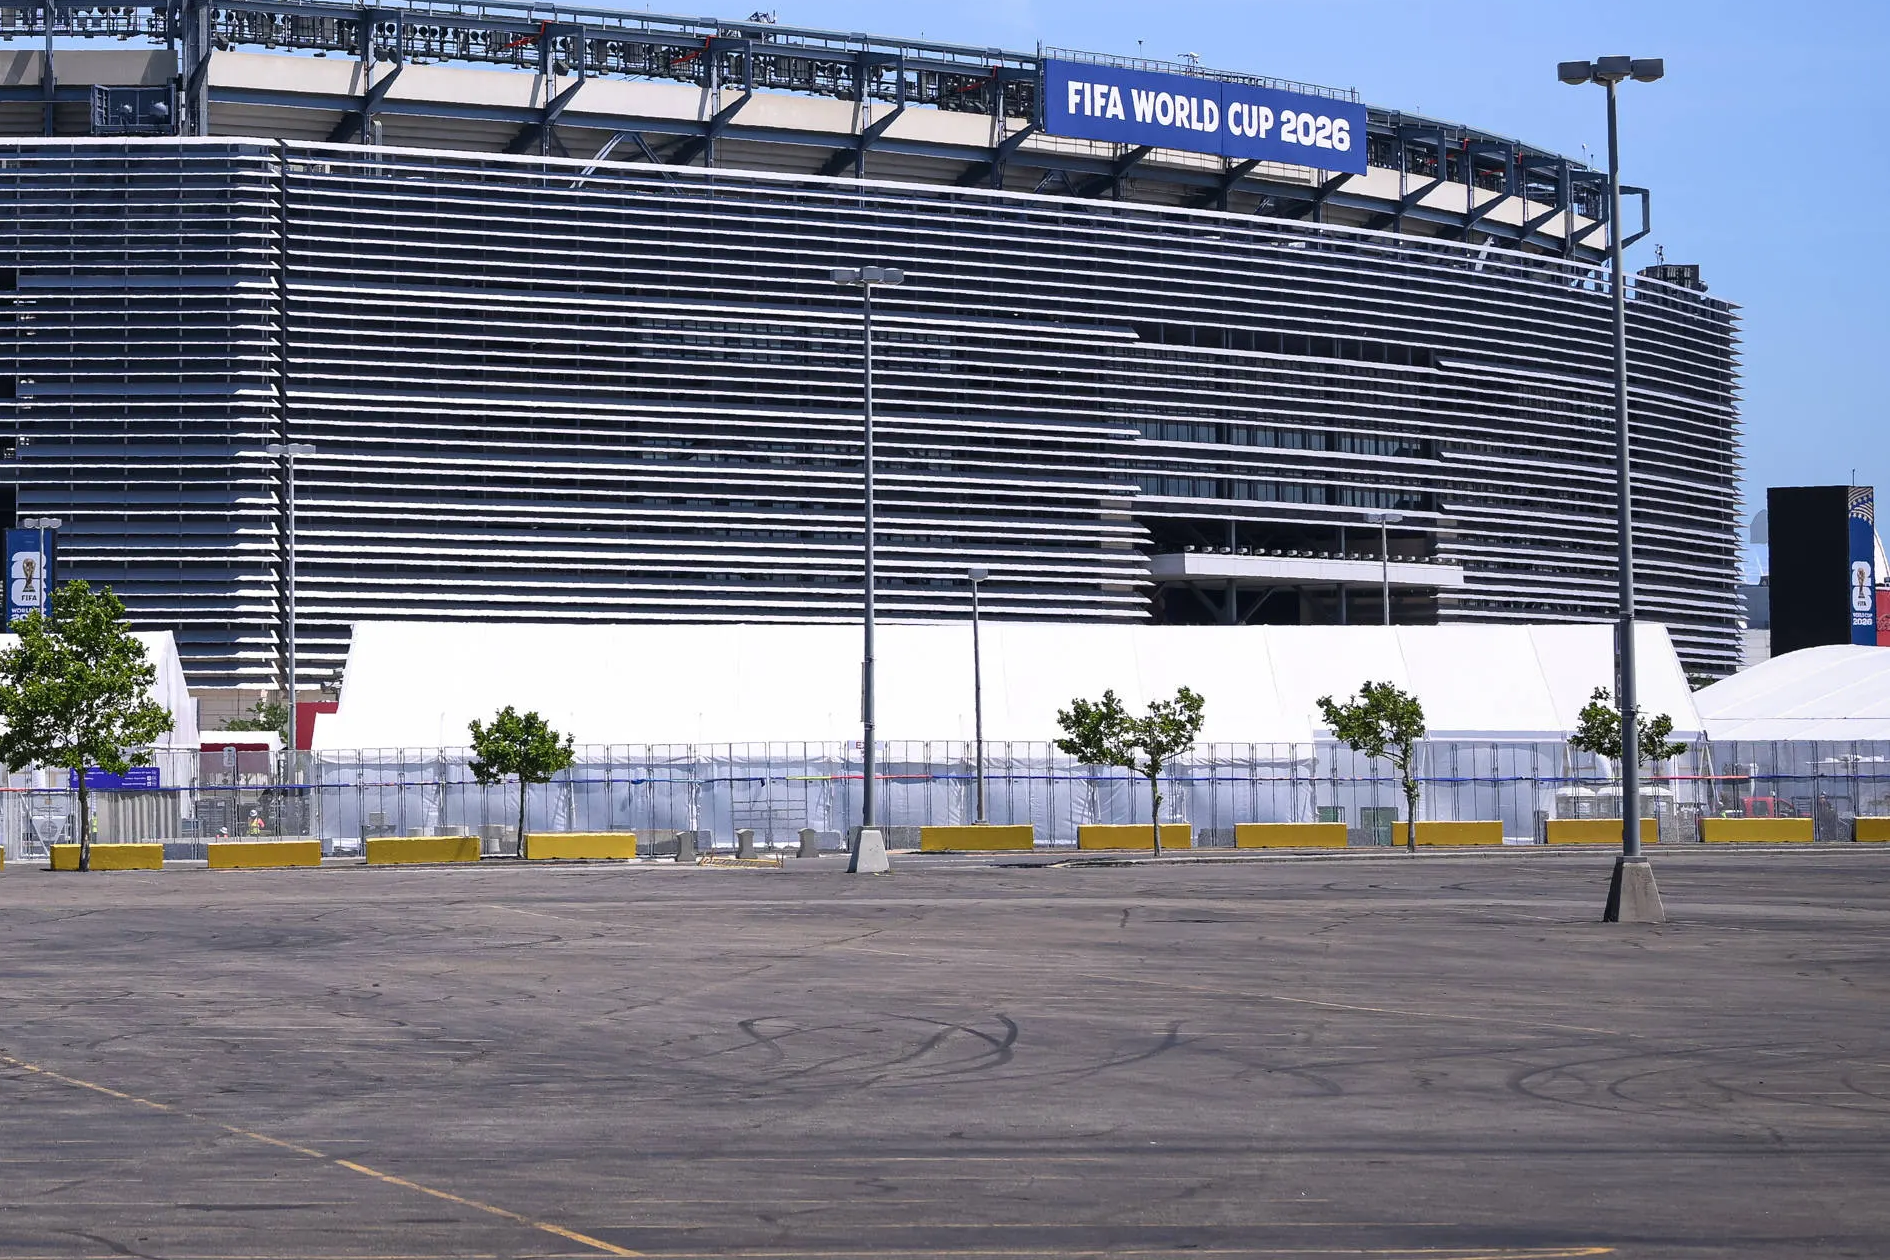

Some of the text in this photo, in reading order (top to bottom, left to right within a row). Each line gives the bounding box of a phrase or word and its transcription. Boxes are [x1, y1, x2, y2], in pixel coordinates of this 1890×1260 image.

[1067, 80, 1351, 152] FIFA WORLD CUP 2026
